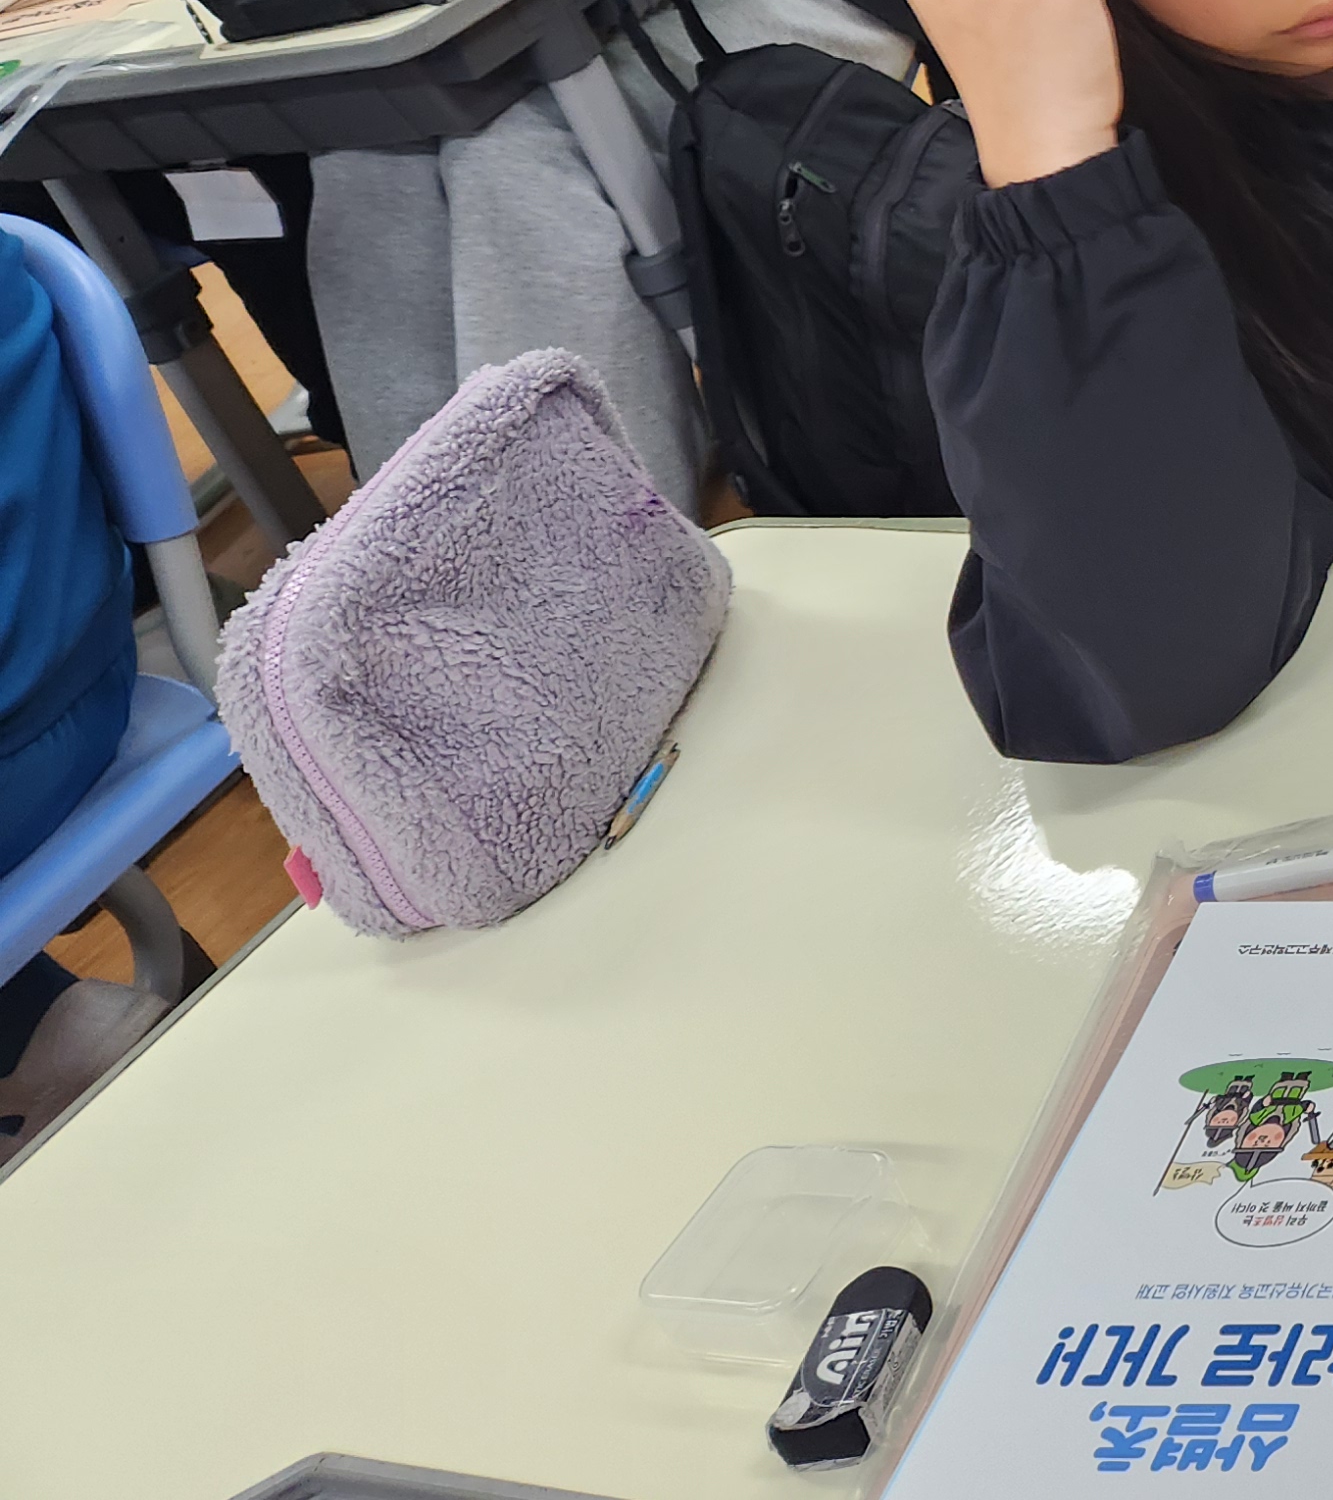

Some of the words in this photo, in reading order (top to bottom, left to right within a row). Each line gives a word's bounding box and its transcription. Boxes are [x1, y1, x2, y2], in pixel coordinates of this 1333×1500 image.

[1237, 942, 1333, 956] 제주고고학연구소
[1231, 1201, 1257, 1215] 이다!
[1259, 1200, 1271, 1214] 것
[1273, 1200, 1294, 1214] 싸울
[1295, 1200, 1329, 1214] 끝까지
[1242, 1213, 1285, 1227] 삼별초는
[1285, 1213, 1309, 1227] 우리
[1134, 1283, 1170, 1299] 교재
[1170, 1283, 1237, 1299] 지원사업
[1035, 1322, 1191, 1388] 가다!
[1088, 1400, 1301, 1473] 삼별초,
